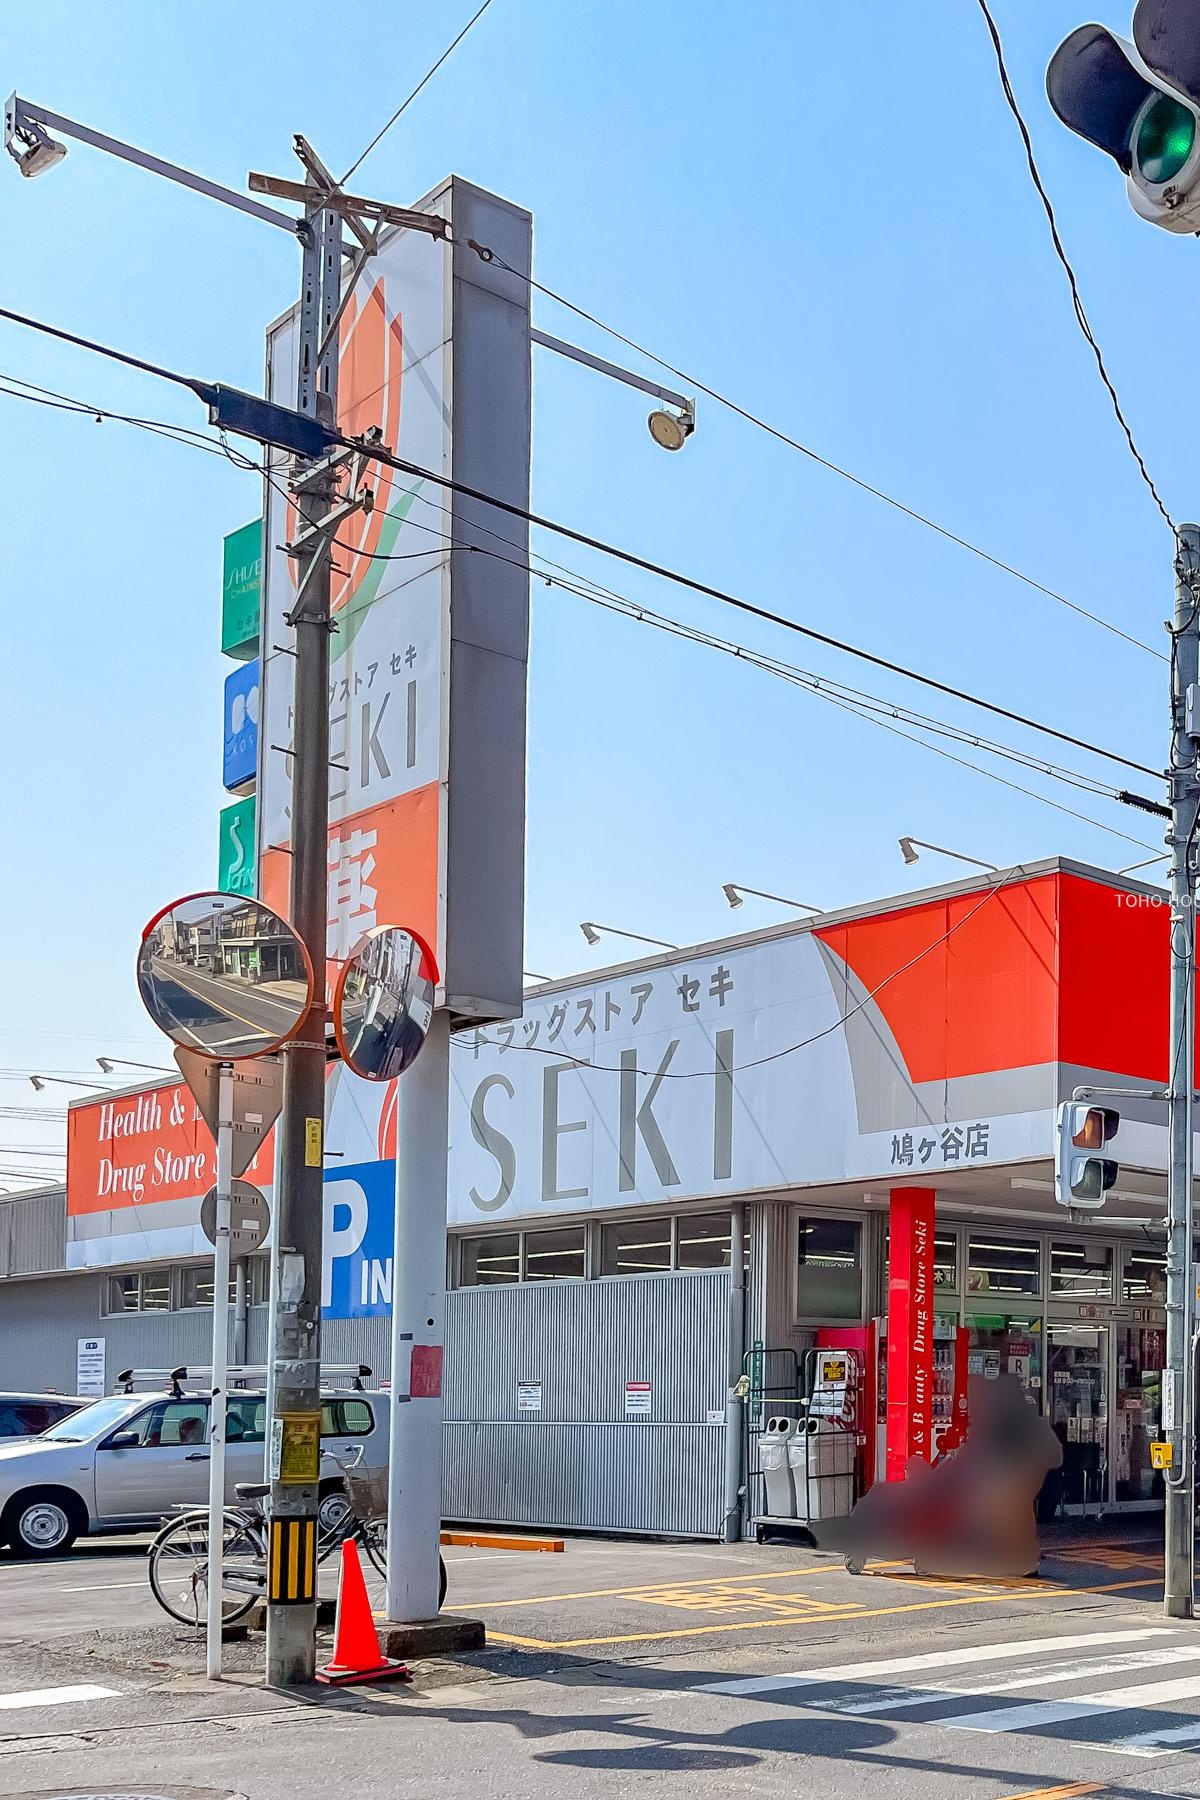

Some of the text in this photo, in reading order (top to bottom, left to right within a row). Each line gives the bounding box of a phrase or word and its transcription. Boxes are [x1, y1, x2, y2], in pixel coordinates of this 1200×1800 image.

[390, 644, 418, 676] セキ
[473, 965, 734, 1060] ドラッグストア セキ
[98, 1089, 185, 1142] Health &
[469, 1029, 734, 1212] SEKI
[890, 1123, 990, 1166] 鳩ヶ谷店
[97, 1158, 146, 1202] Drug
[151, 1147, 206, 1187] Store
[323, 1178, 369, 1308] P
[914, 1219, 928, 1256] Seki
[913, 1261, 927, 1305] Store
[913, 1310, 929, 1353] Drug
